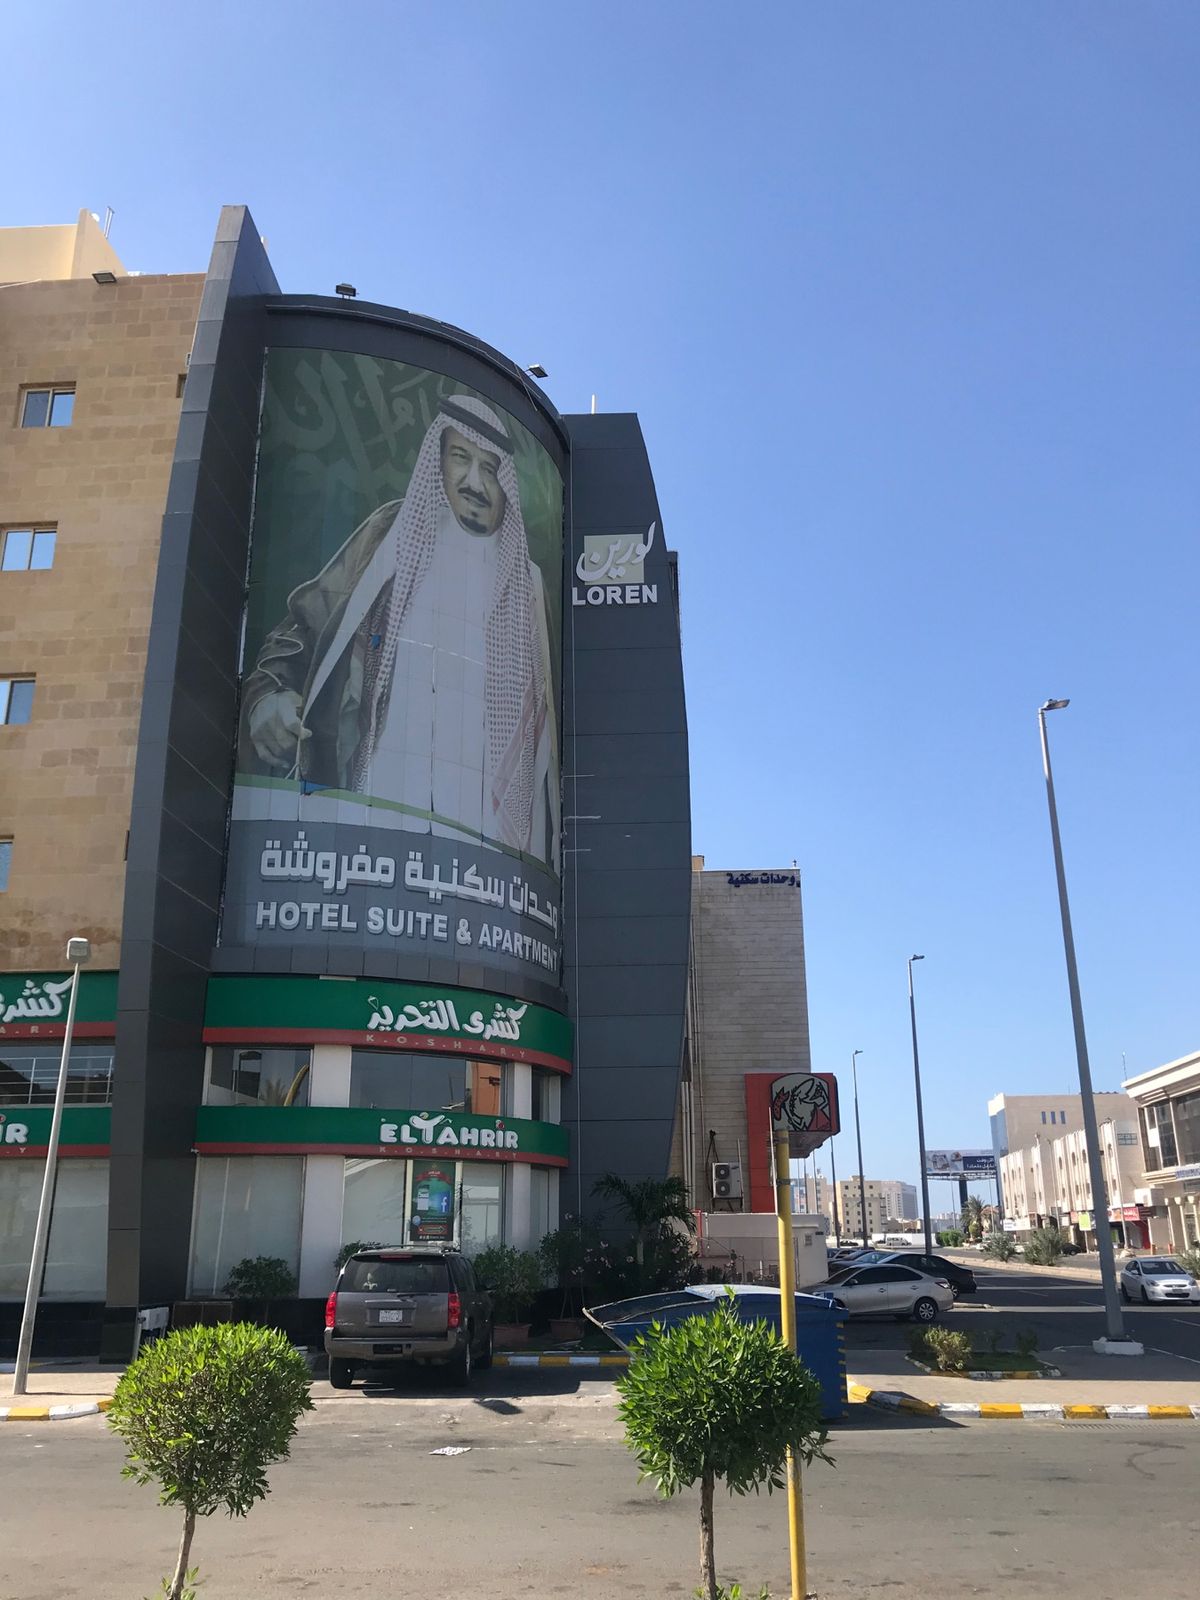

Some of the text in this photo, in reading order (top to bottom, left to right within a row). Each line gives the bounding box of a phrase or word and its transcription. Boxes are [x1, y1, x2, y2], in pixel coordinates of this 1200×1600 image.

[576, 521, 656, 581] لورين
[572, 584, 658, 605] LOREN
[260, 831, 558, 940] وحدات سكنية مفروشة
[255, 901, 558, 972] HOTEL SUITE & APARTMENT
[367, 1000, 461, 1032] التحرير
